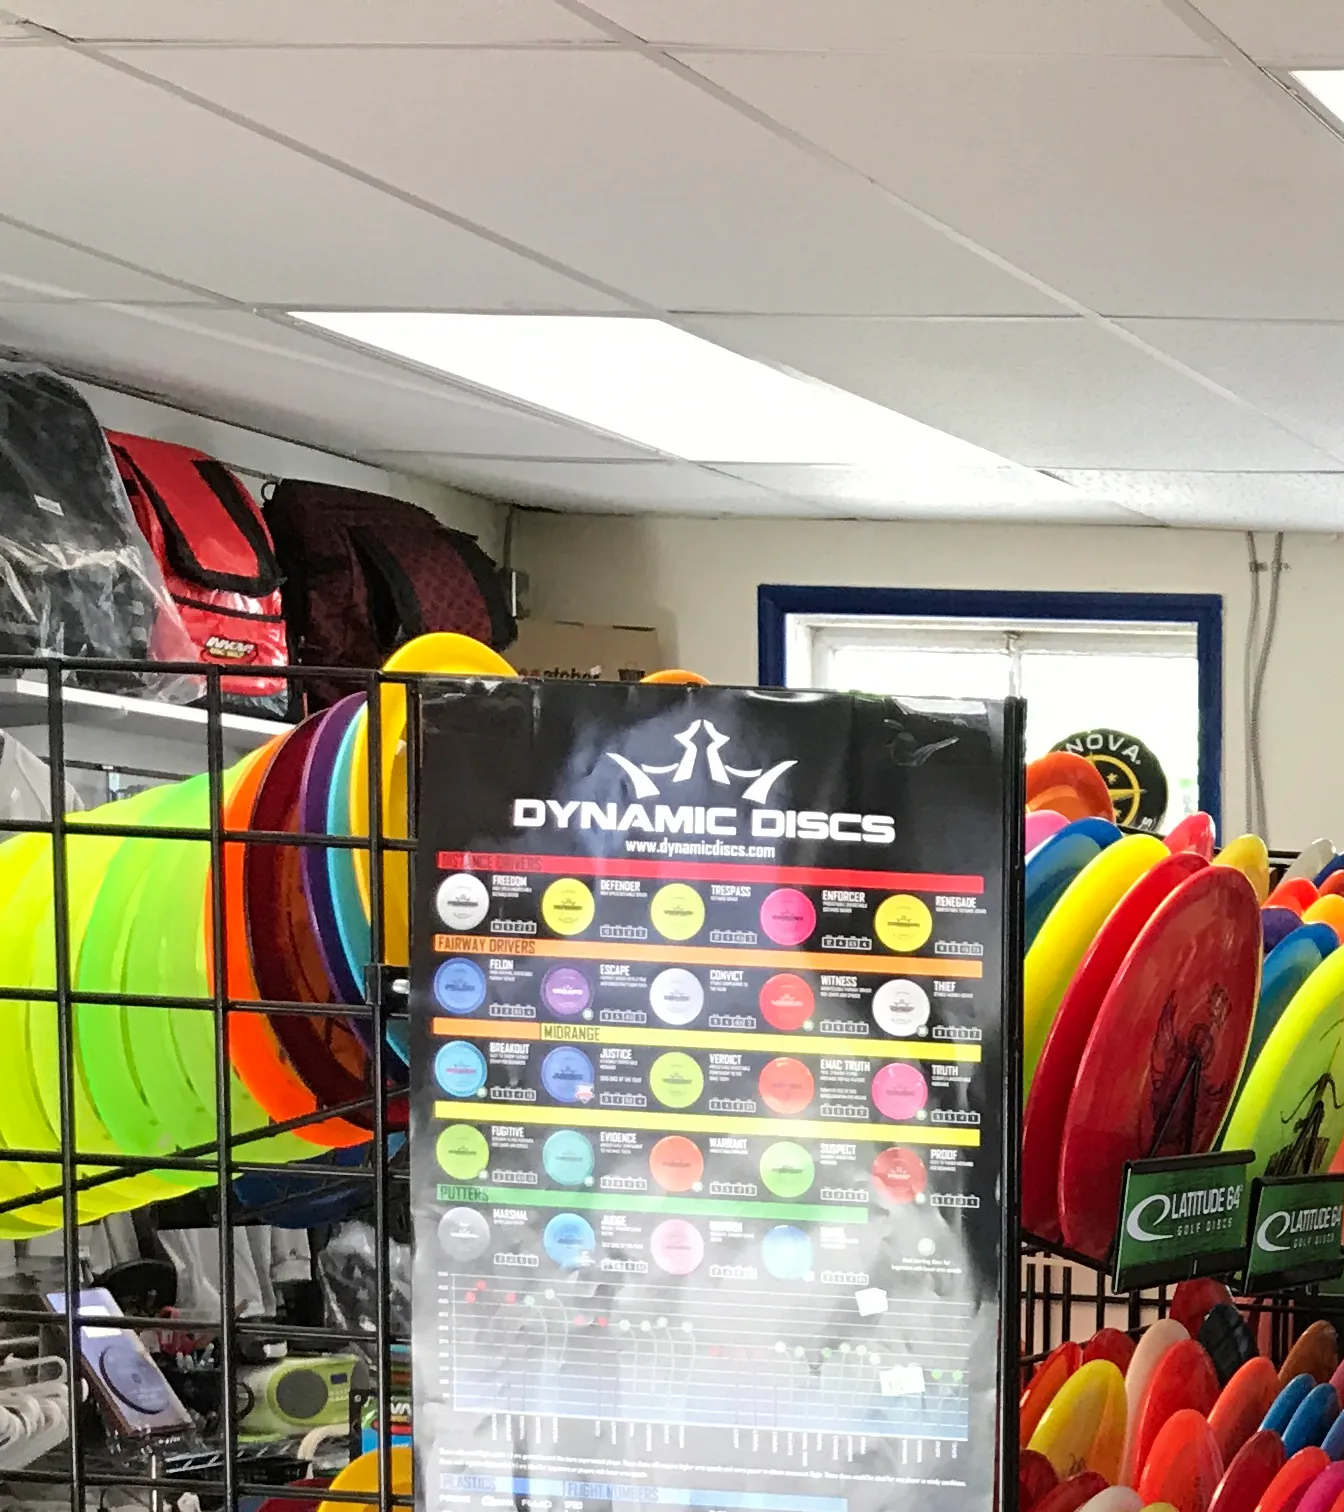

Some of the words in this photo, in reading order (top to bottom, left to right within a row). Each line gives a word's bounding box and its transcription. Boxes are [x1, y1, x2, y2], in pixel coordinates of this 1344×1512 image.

[206, 637, 254, 652] INNOVA
[1065, 734, 1141, 764] NOVA
[513, 798, 738, 836] DYNAMIC
[751, 808, 896, 844] DISCS
[625, 838, 776, 858] www.dynamicdiscs.com
[492, 875, 527, 887] FREEDOM
[600, 880, 640, 891] DEFENDER
[711, 885, 751, 897] TRESPASS
[822, 890, 865, 902] ENFORCER
[935, 896, 976, 908] RENEGADE
[438, 936, 485, 952] FAIRWAY
[489, 939, 536, 954] DRIVERS
[489, 959, 514, 970] FELON
[600, 964, 630, 976] ESCAPE
[710, 969, 744, 981] CONVICT
[821, 976, 857, 988] WITNESS
[934, 981, 956, 992] THIEF
[544, 1026, 600, 1041] MIDRANGE
[489, 1043, 530, 1055] BREAKOUT
[600, 1049, 632, 1060] JUSTICE
[709, 1054, 742, 1065] VERDICT
[844, 1061, 870, 1072] TRUTH
[932, 1065, 958, 1076] TRUTH
[491, 1126, 524, 1138] FUGITIVE
[600, 1132, 637, 1143] EVIDENCE
[931, 1149, 958, 1161] PROOF
[440, 1186, 489, 1201] PUTTERS
[1171, 1187, 1224, 1219] LATITUDE
[1290, 1208, 1329, 1233] LATITUDE
[1177, 1222, 1202, 1237] GOLF
[1206, 1217, 1233, 1233] DISCS
[567, 1481, 602, 1498] FLIGHT
[606, 1484, 659, 1500] NUMBERS
